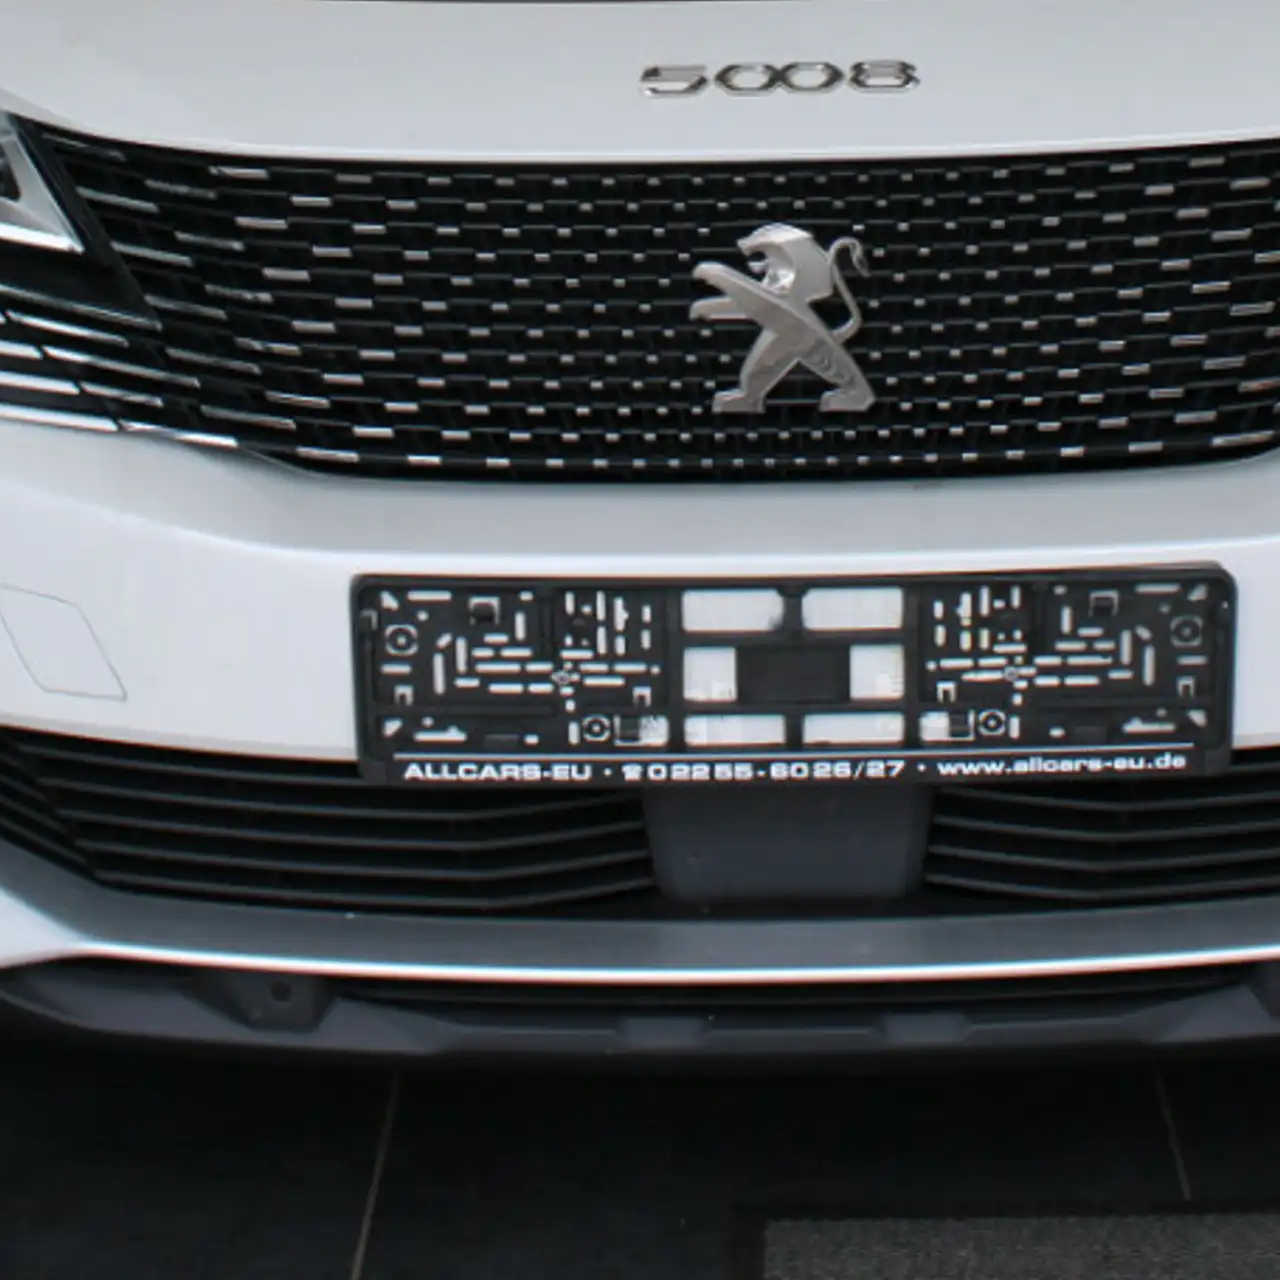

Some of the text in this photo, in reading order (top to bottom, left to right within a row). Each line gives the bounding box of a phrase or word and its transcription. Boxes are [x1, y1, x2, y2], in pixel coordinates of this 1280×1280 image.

[639, 59, 921, 98] 5008
[404, 762, 592, 781] ALLCARS-EU
[936, 751, 1188, 777] www.allcars-eu.de
